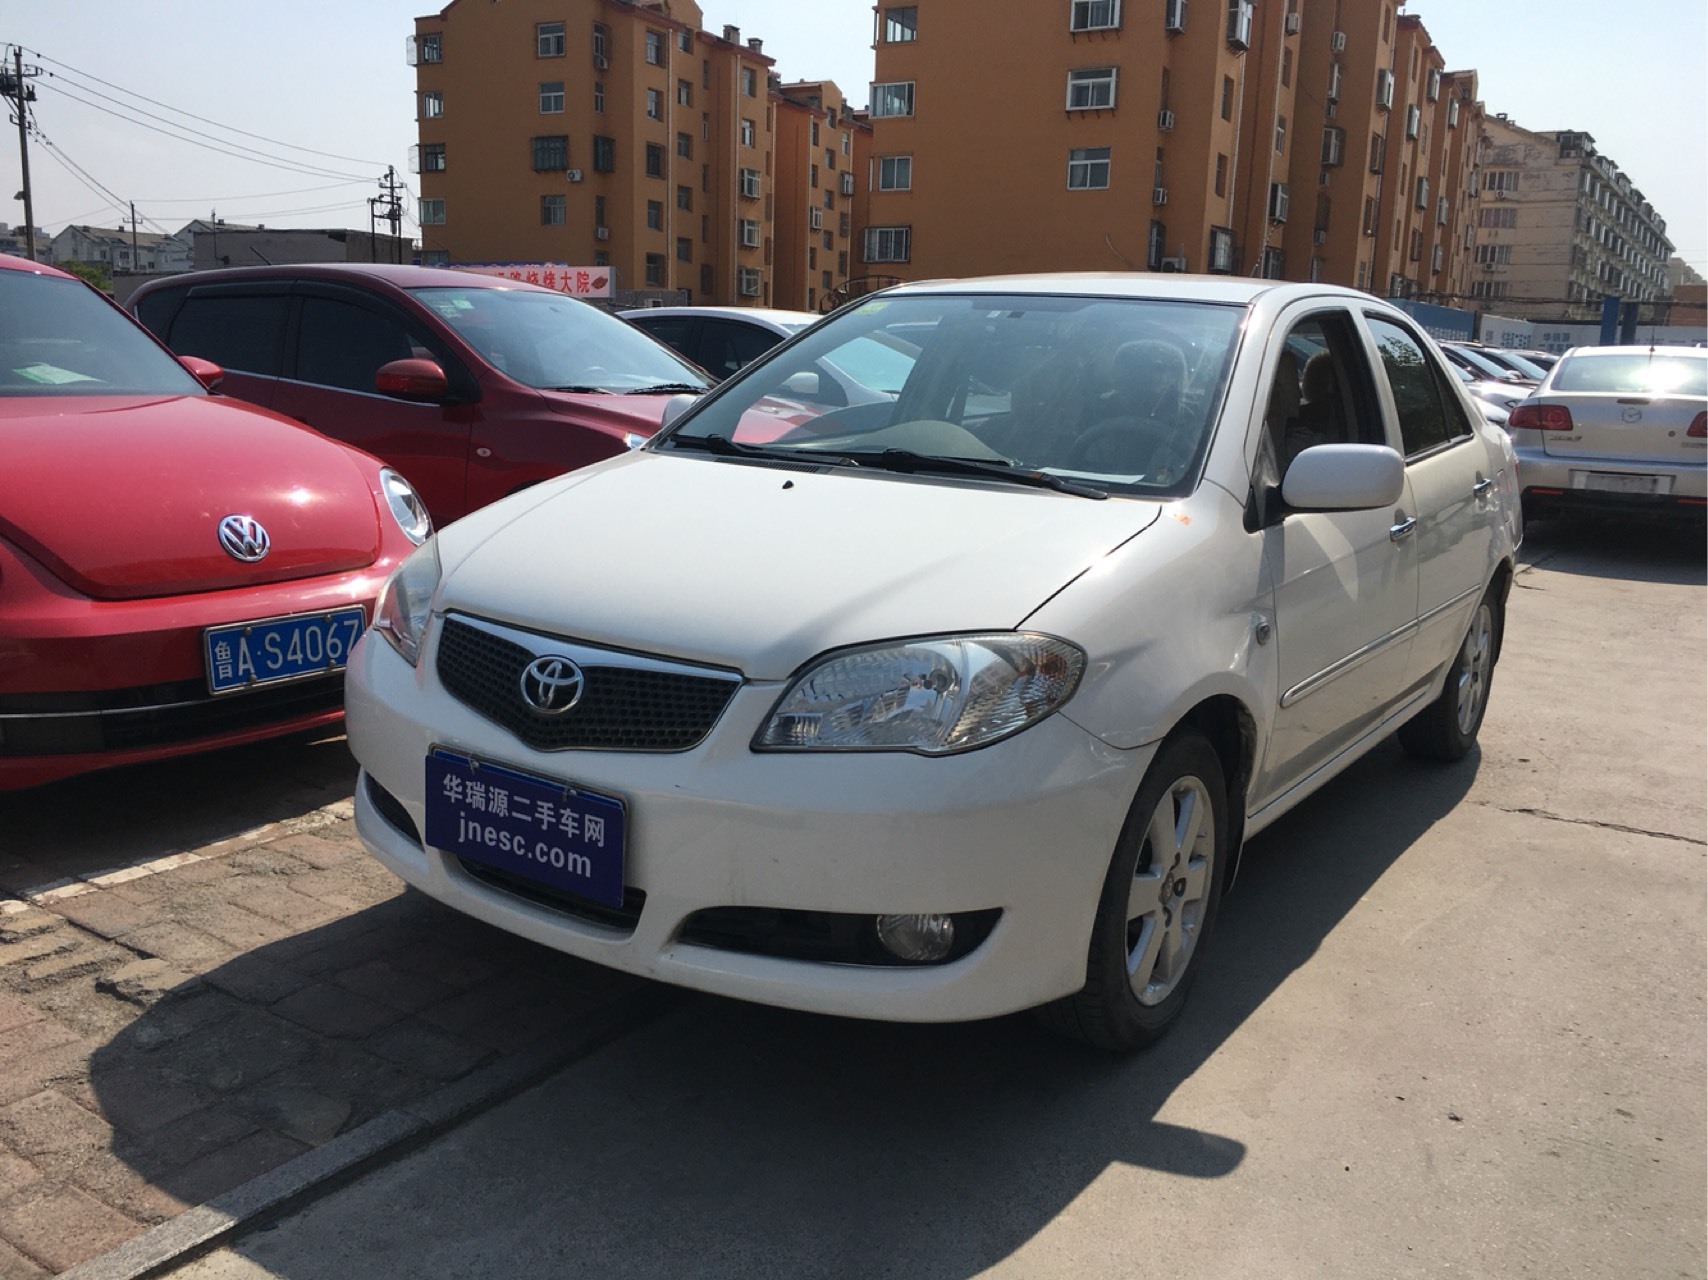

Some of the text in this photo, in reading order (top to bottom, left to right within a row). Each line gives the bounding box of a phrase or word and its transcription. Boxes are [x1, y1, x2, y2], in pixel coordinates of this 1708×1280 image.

[442, 772, 605, 847] 华瑞源二手车网
[458, 811, 591, 878] jnesc.com
